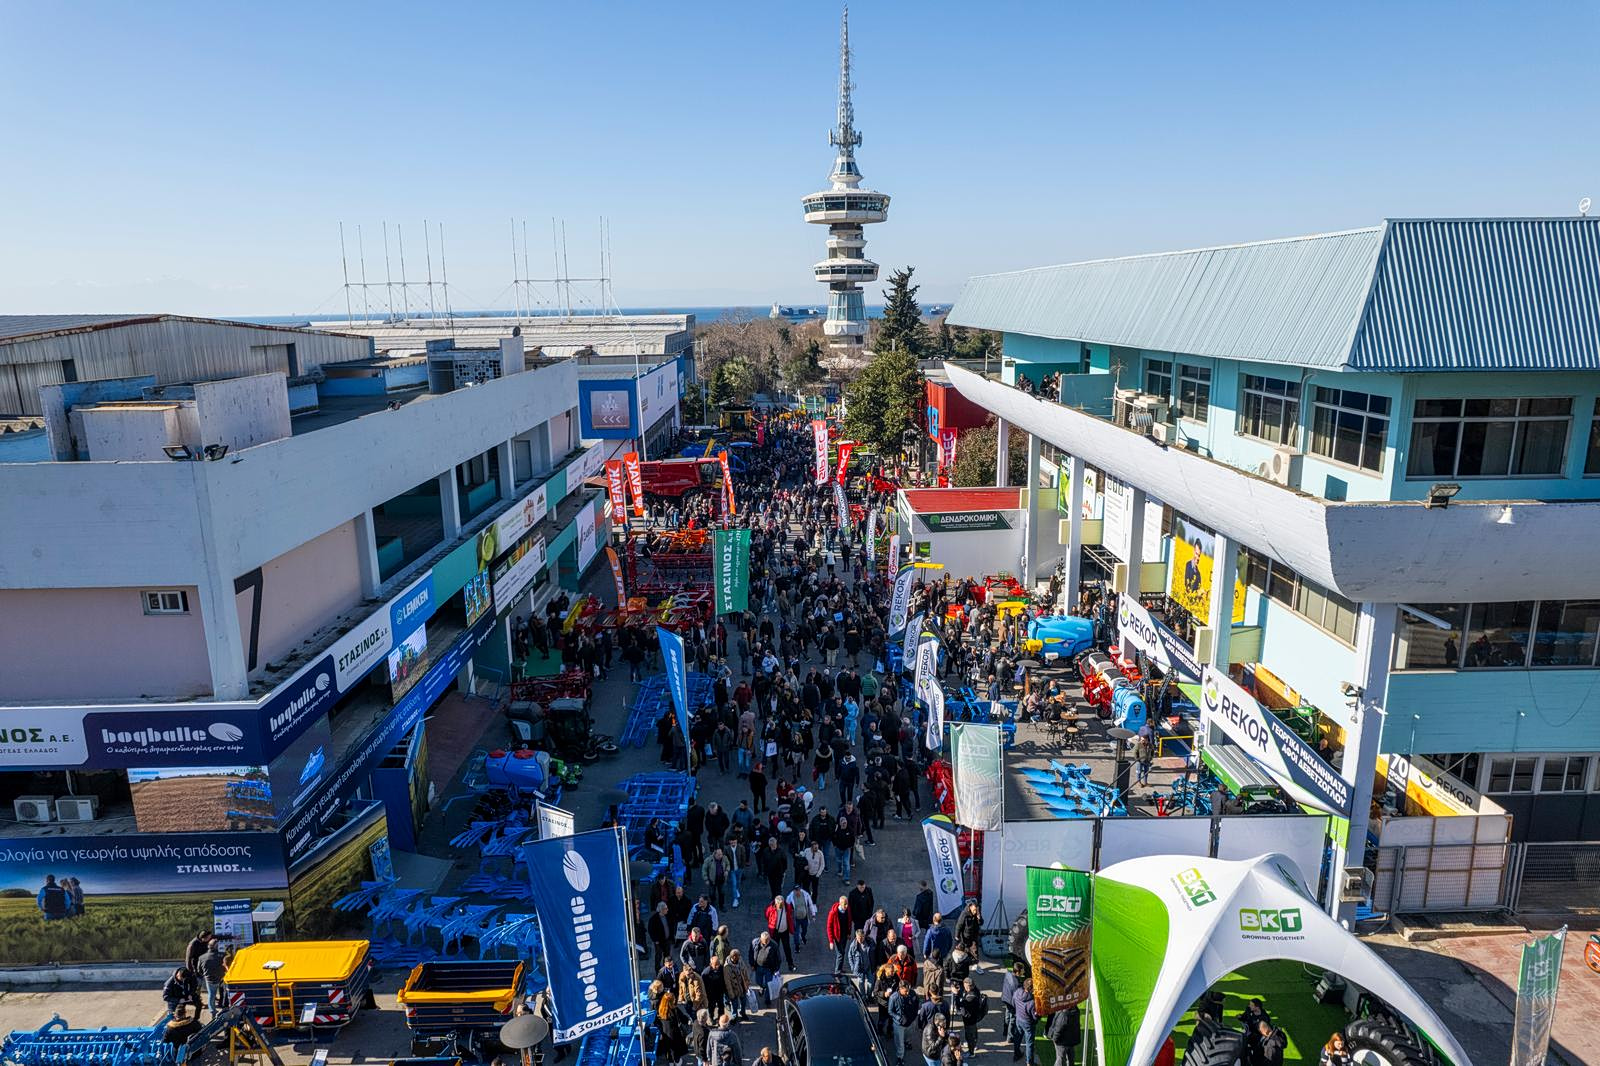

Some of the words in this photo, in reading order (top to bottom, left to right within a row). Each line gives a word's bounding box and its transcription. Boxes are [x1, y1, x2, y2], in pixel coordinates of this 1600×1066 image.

[940, 514, 998, 523] ΔΕΝΔΡΟΚΟΜΙΚΗ
[723, 544, 733, 611] ΣΤΑΣΙΝΟΣ
[402, 587, 428, 620] LEMKEN
[895, 579, 906, 611] REKOR
[1129, 612, 1157, 651] REKOR
[339, 629, 381, 672] ΣΤΑΣΙΝΟΣ
[921, 649, 930, 676] REKOR
[1221, 695, 1269, 753] REKOR
[1390, 753, 1409, 779] 70
[1436, 776, 1473, 808] REKOR
[47, 849, 68, 862] για
[71, 845, 128, 862] γεωργία
[131, 844, 181, 860] υψηλής
[184, 843, 252, 858] απόδοσης
[176, 864, 240, 874] ΣΤΑΣΙΝΟΣ
[1178, 868, 1216, 906] BKT
[1037, 895, 1082, 913] BKT
[1240, 909, 1302, 931] BKT
